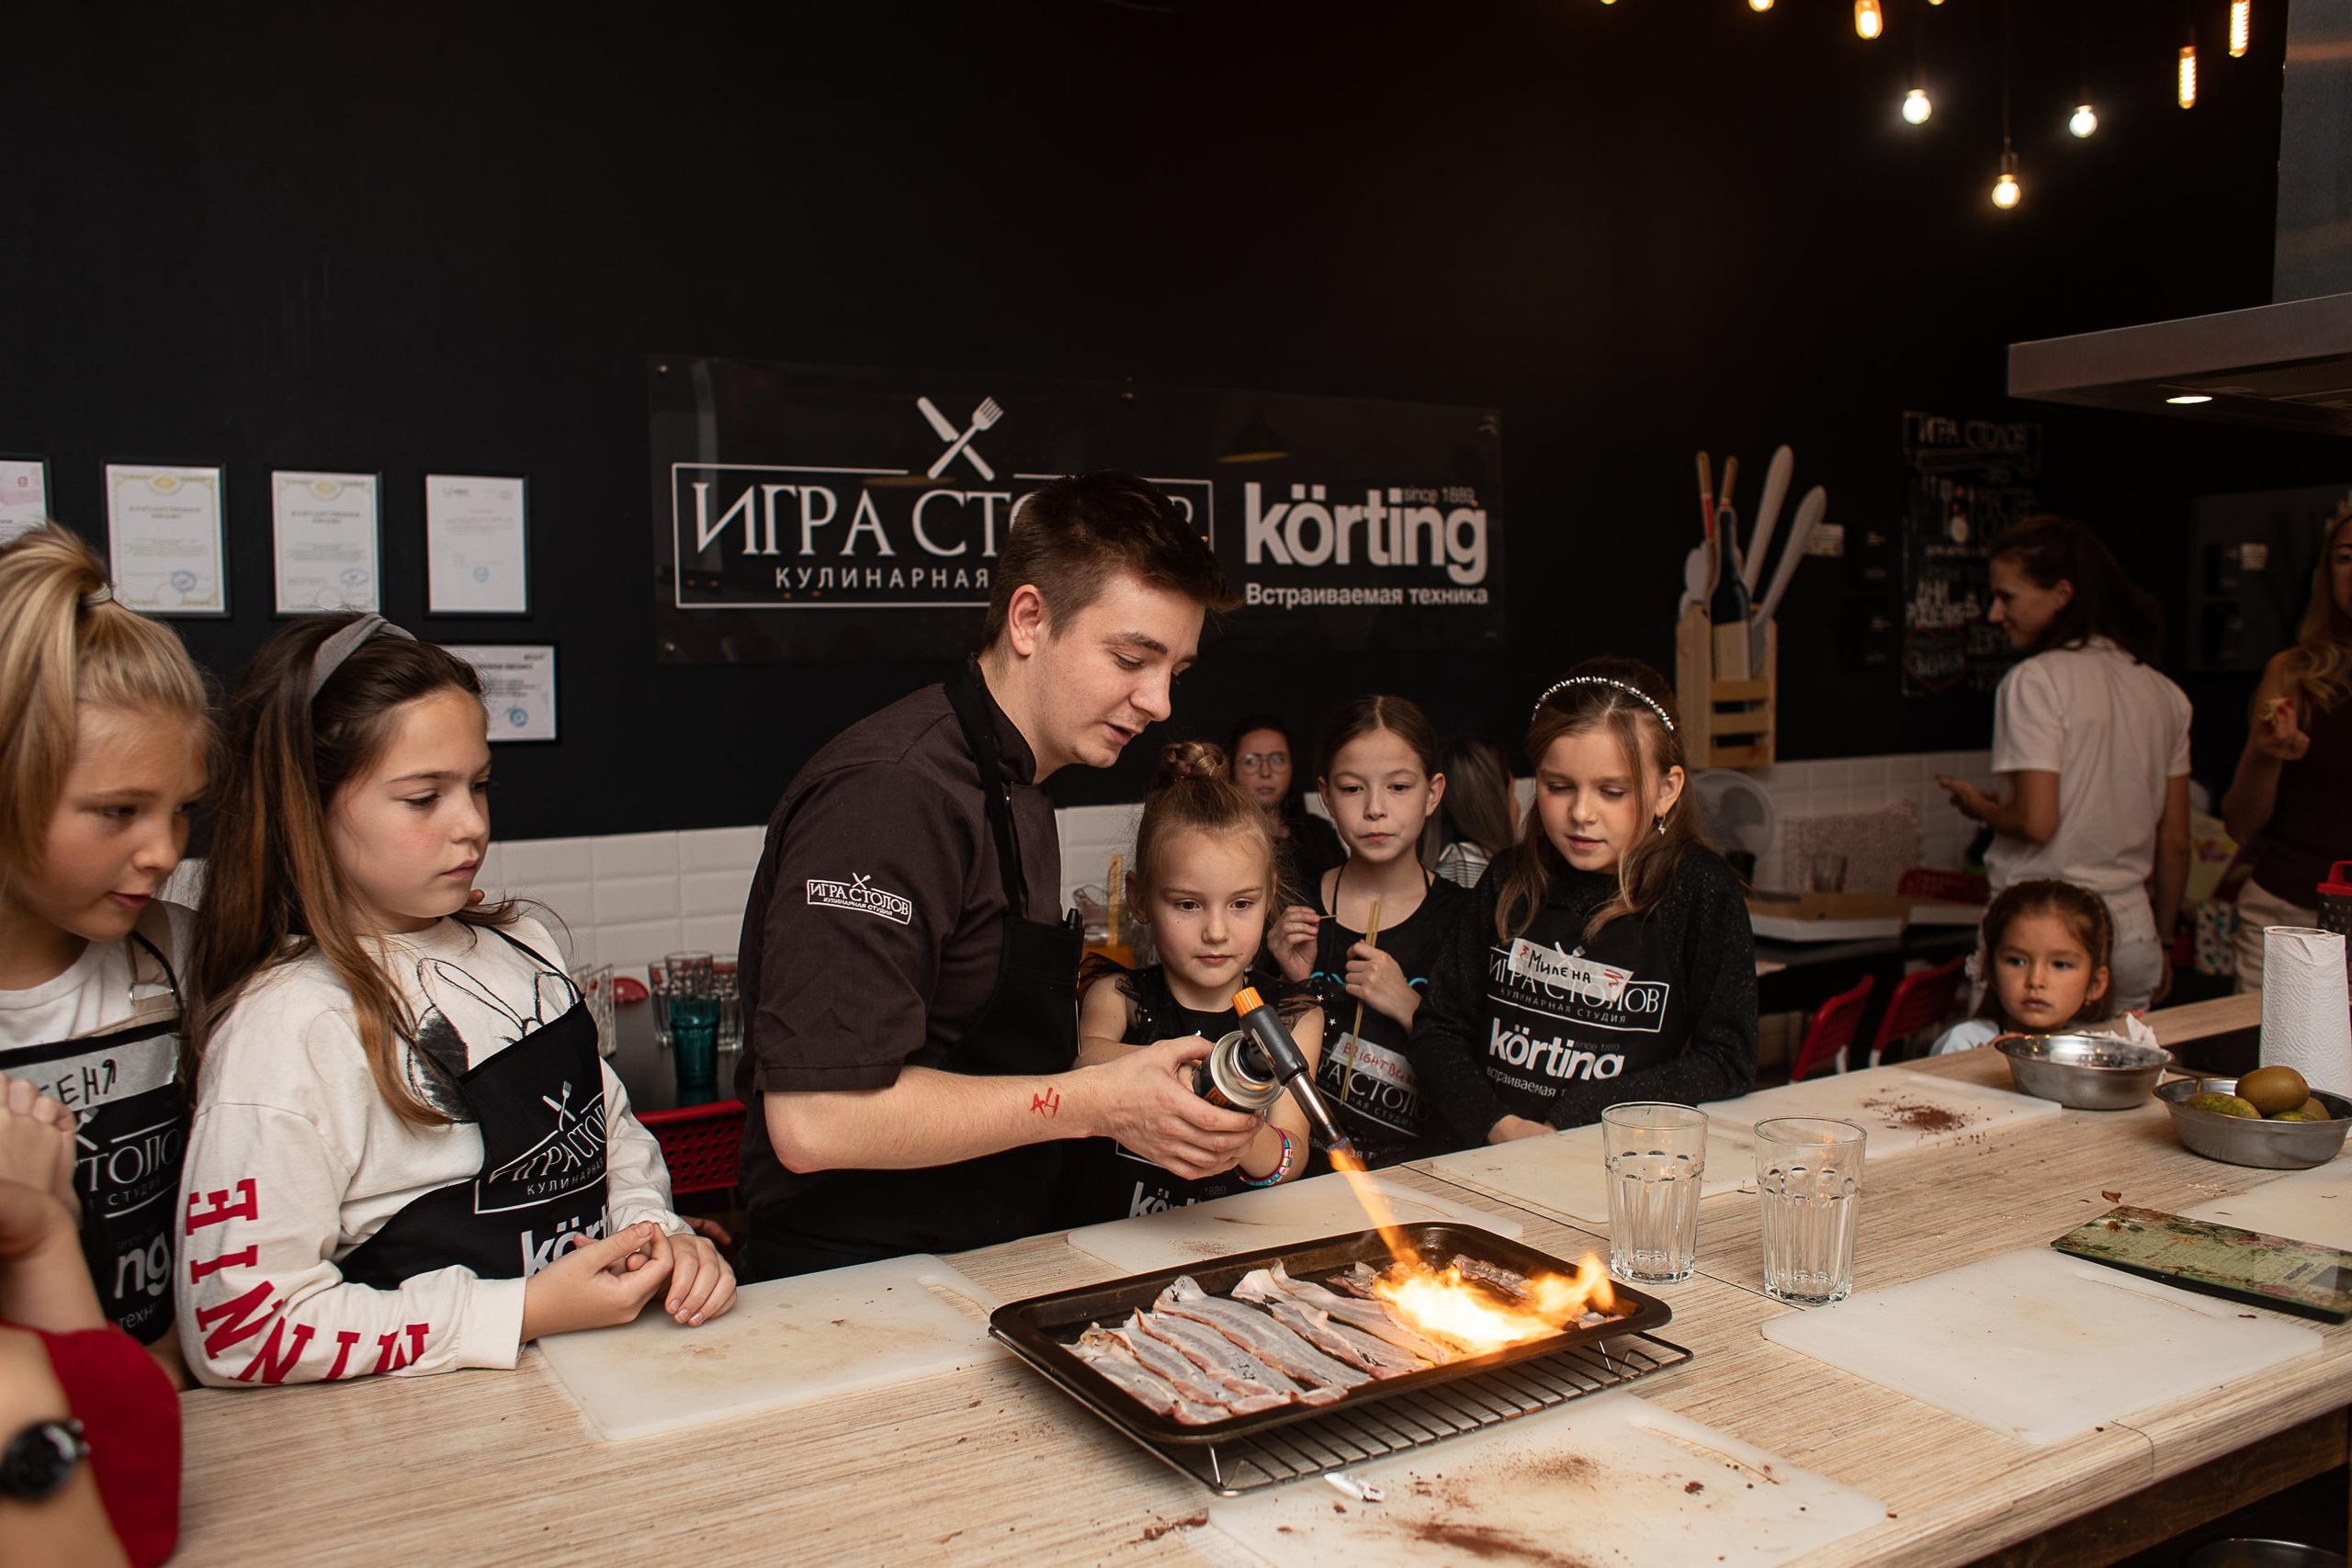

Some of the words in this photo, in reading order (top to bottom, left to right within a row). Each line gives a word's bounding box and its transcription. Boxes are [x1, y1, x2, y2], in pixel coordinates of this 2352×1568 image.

[1404, 485, 1438, 504] since
[692, 482, 895, 556] ИГРА
[1245, 482, 1487, 585] körting
[775, 567, 989, 590] КУЛИНАРНАЯ
[1246, 582, 1403, 610] Встраиваемая
[1409, 587, 1488, 605] техника
[810, 883, 848, 900] ИГРА
[849, 888, 909, 916] СТОЛОВ
[823, 897, 866, 908] КУЛИНАРНАЯ
[867, 904, 893, 917] СТУДИЯ
[1489, 954, 1537, 994] ИГРА
[1500, 987, 1571, 1013] КУЛИНАРНАЯ
[1577, 1008, 1626, 1024] СТУДИЯ
[40, 1059, 117, 1105] ЕНЯ
[567, 1104, 606, 1158] СТОЛ
